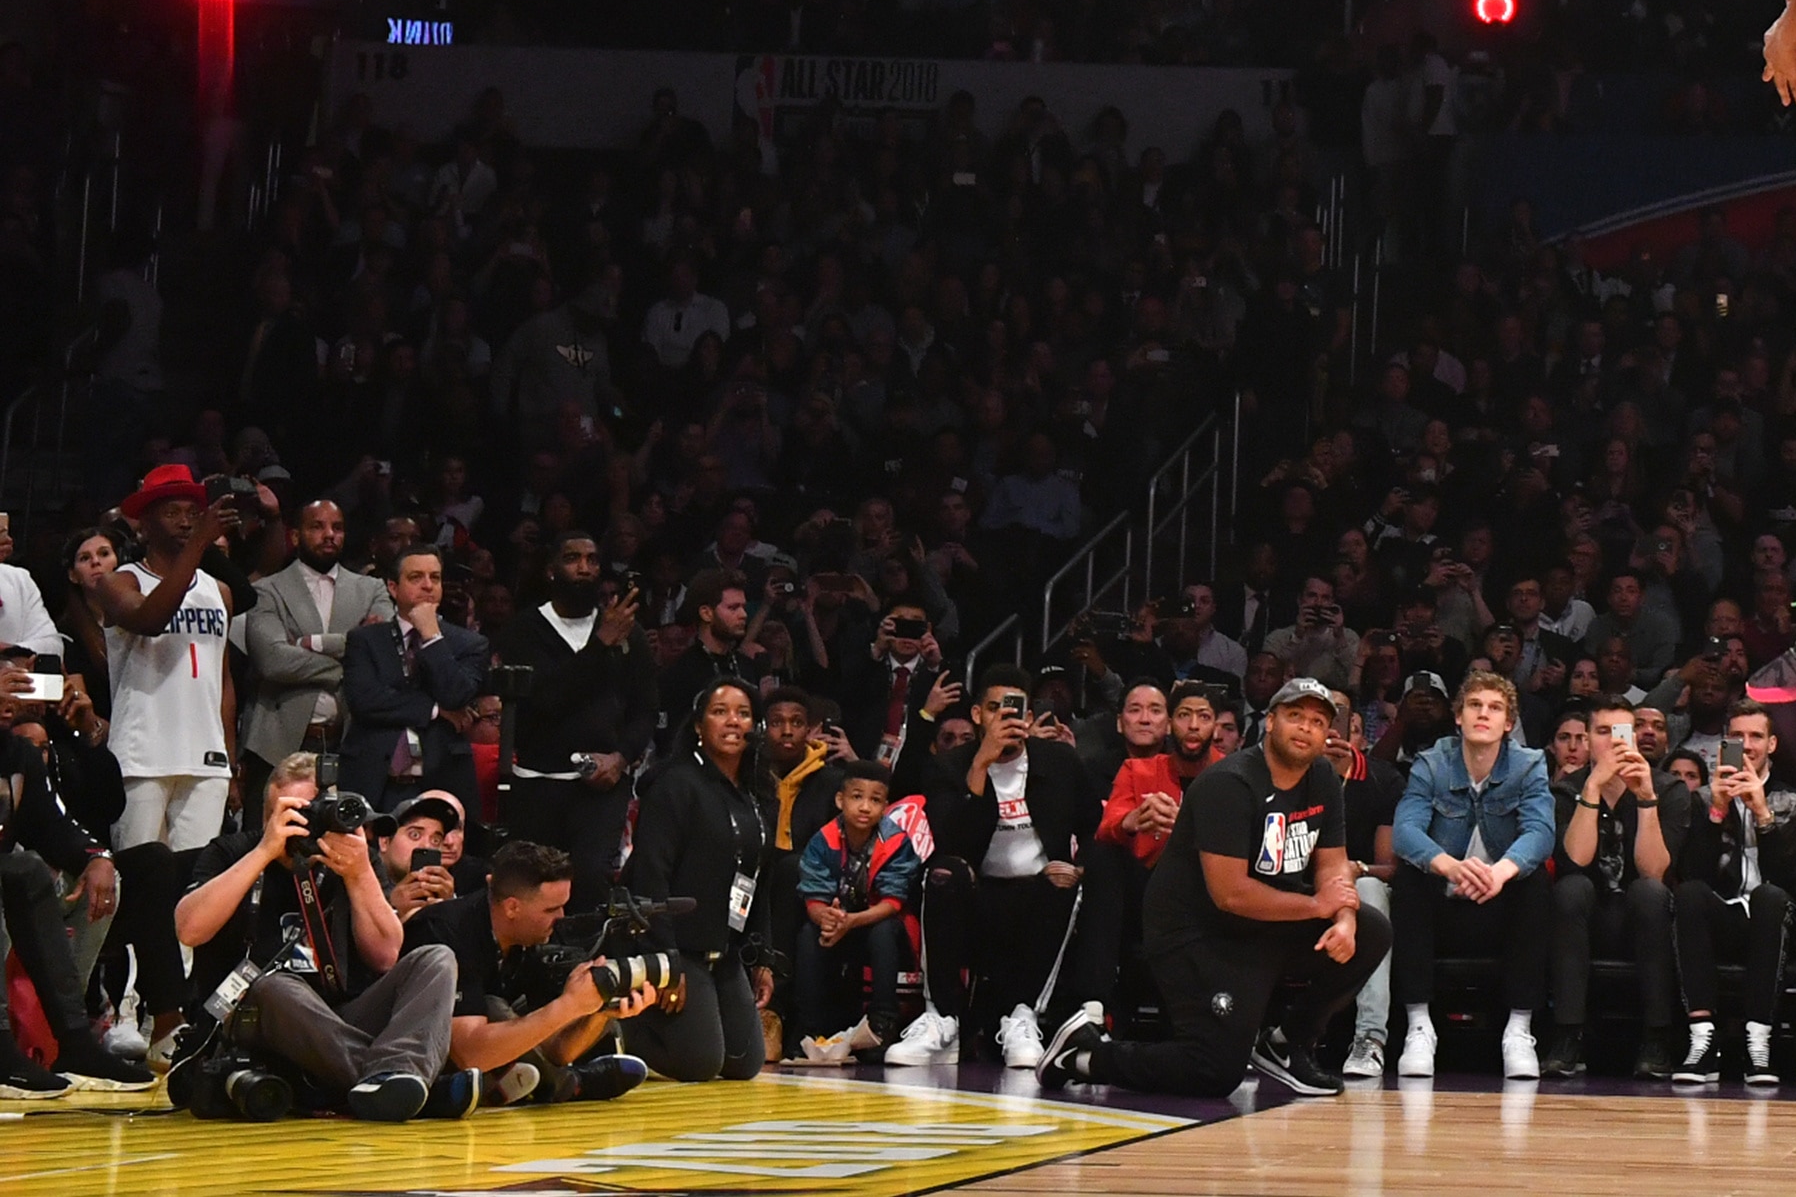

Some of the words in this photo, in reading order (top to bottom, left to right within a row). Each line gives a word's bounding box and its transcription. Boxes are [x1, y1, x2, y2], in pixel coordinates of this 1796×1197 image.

[781, 58, 818, 99] ALL
[827, 59, 884, 101] STAR
[889, 60, 940, 103] 2018
[165, 608, 224, 637] IPPERS
[190, 643, 198, 679] 1
[301, 880, 315, 904] EOS
